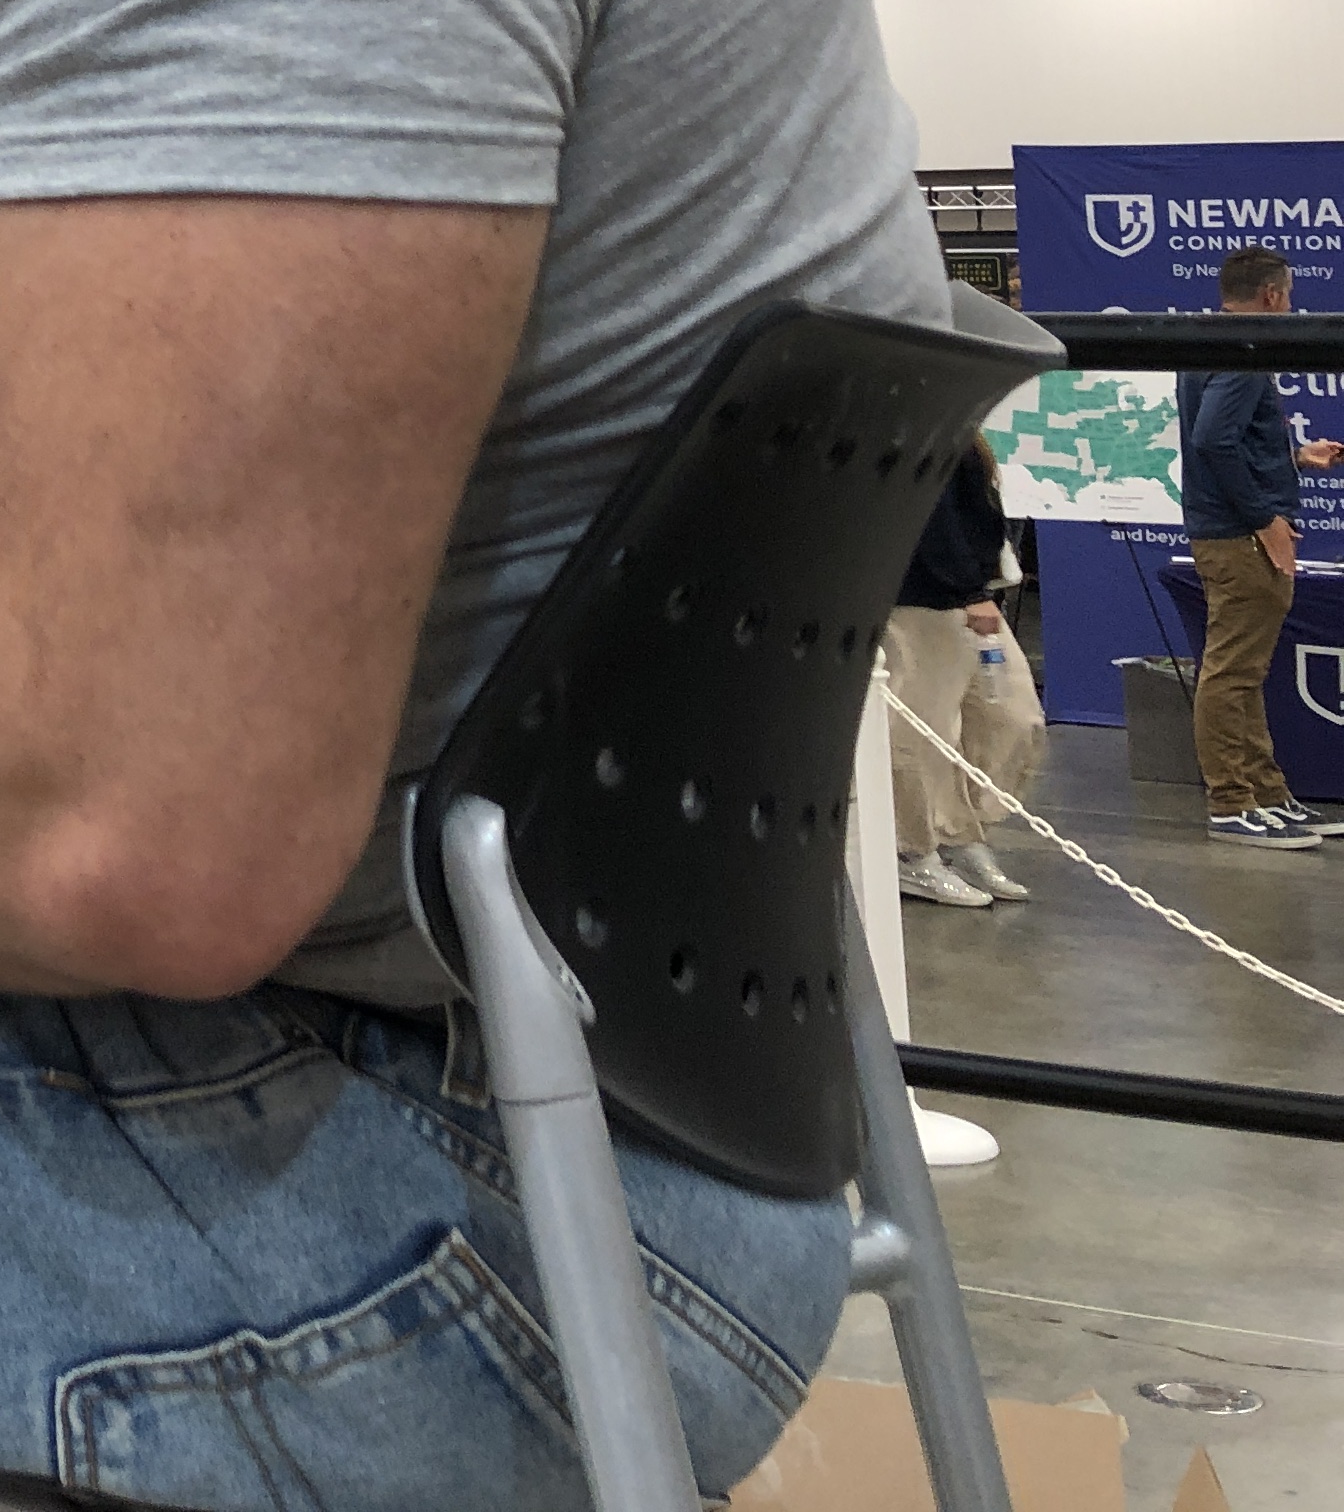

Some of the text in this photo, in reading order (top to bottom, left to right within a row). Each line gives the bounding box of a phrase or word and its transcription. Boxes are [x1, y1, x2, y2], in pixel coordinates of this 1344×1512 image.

[1168, 234, 1342, 251] CONNECTION
[1172, 263, 1193, 280] By
[1291, 263, 1334, 280] nistry
[1110, 528, 1143, 542] and
